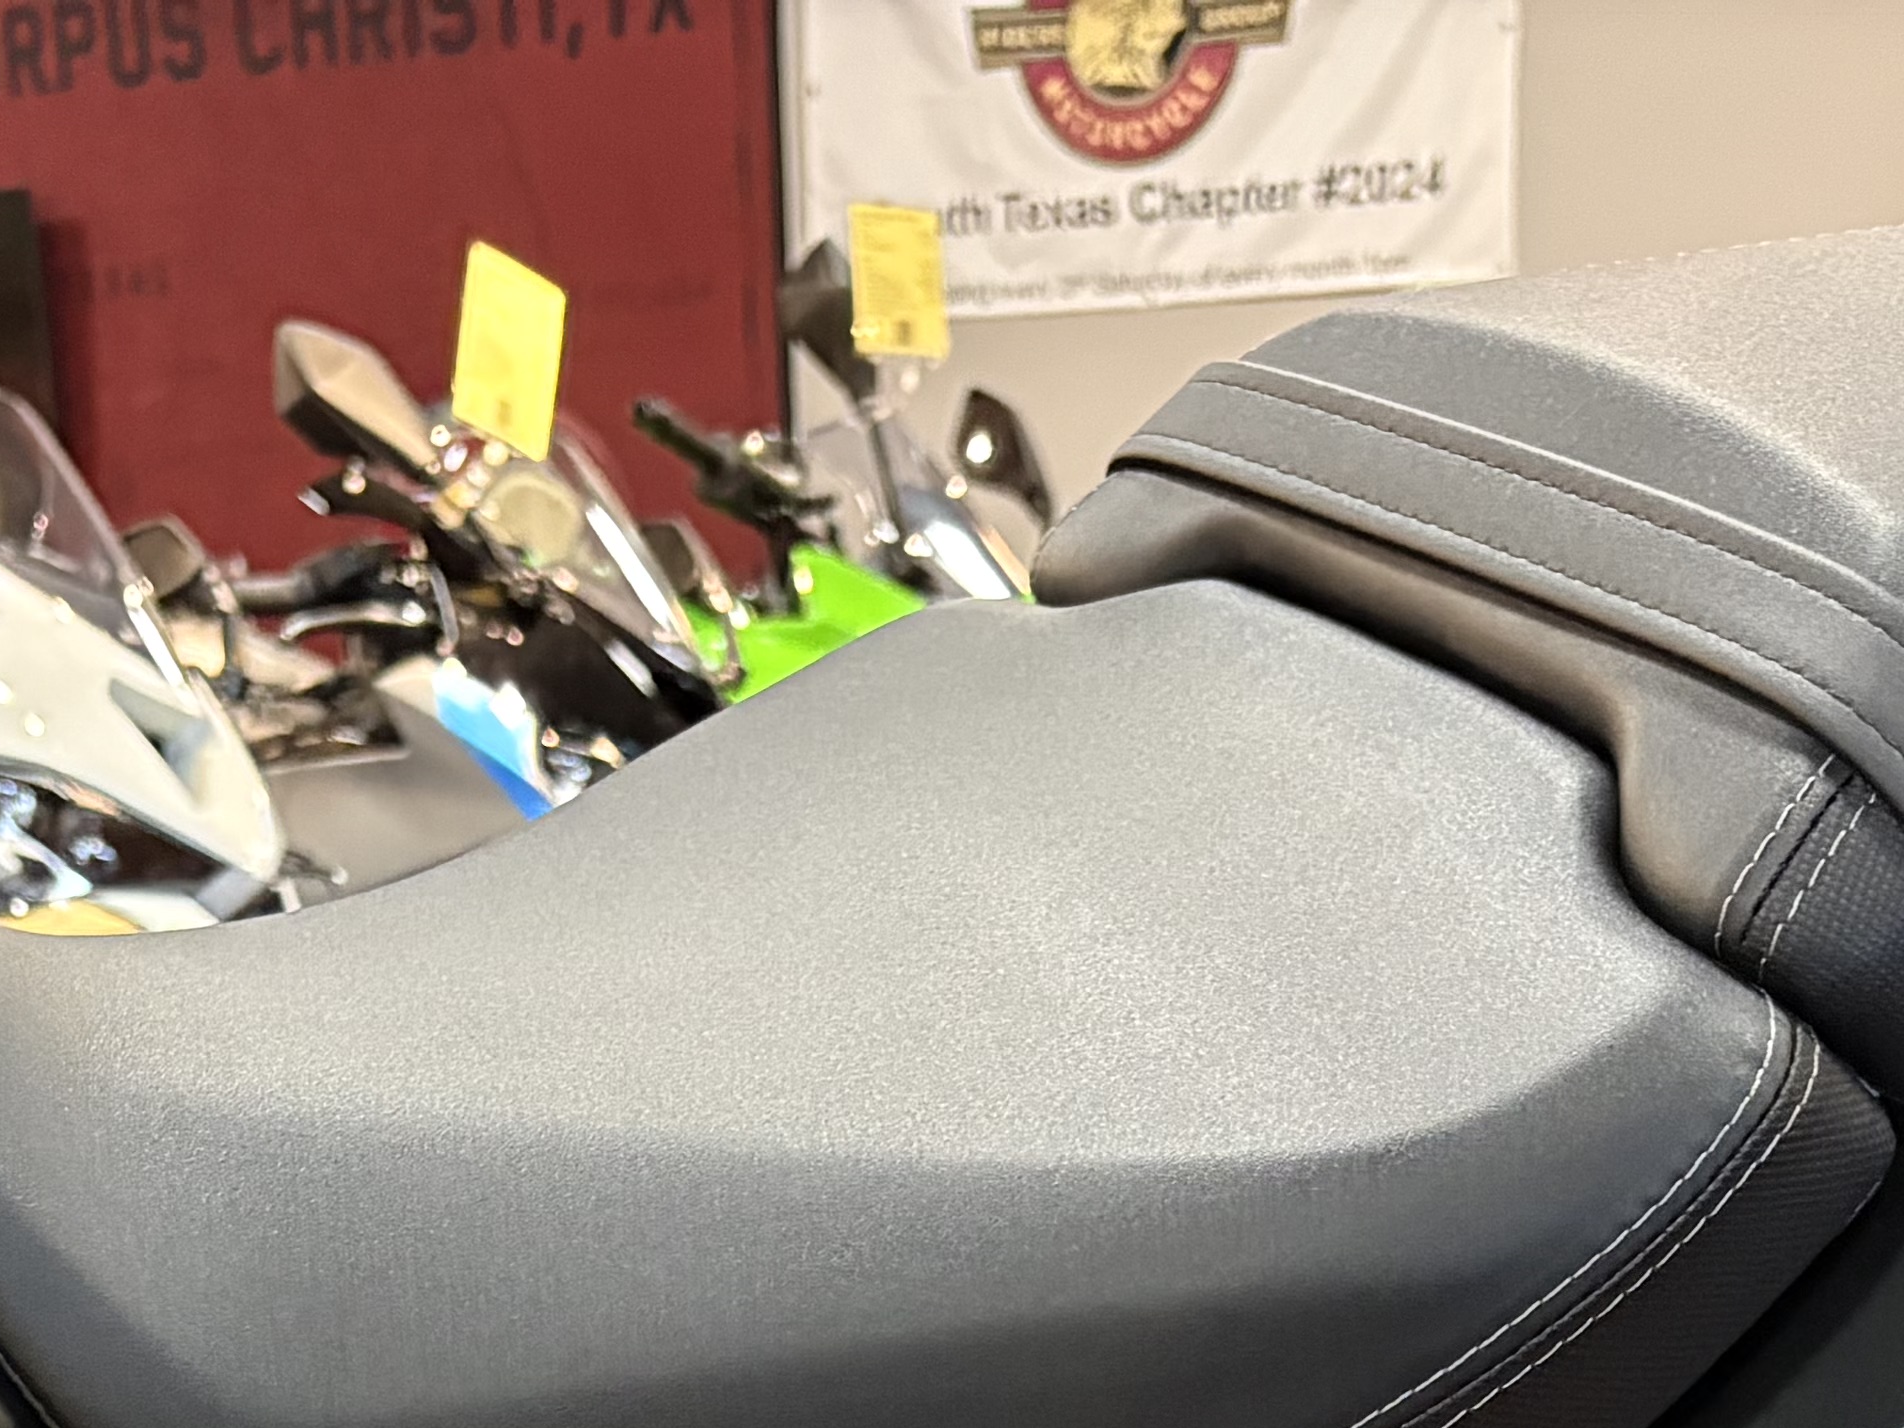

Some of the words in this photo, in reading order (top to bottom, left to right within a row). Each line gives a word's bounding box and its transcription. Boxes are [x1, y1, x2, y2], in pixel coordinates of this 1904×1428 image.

[995, 190, 1119, 234] Texas
[1127, 173, 1302, 230] Chapter
[1313, 155, 1447, 210] #2024
